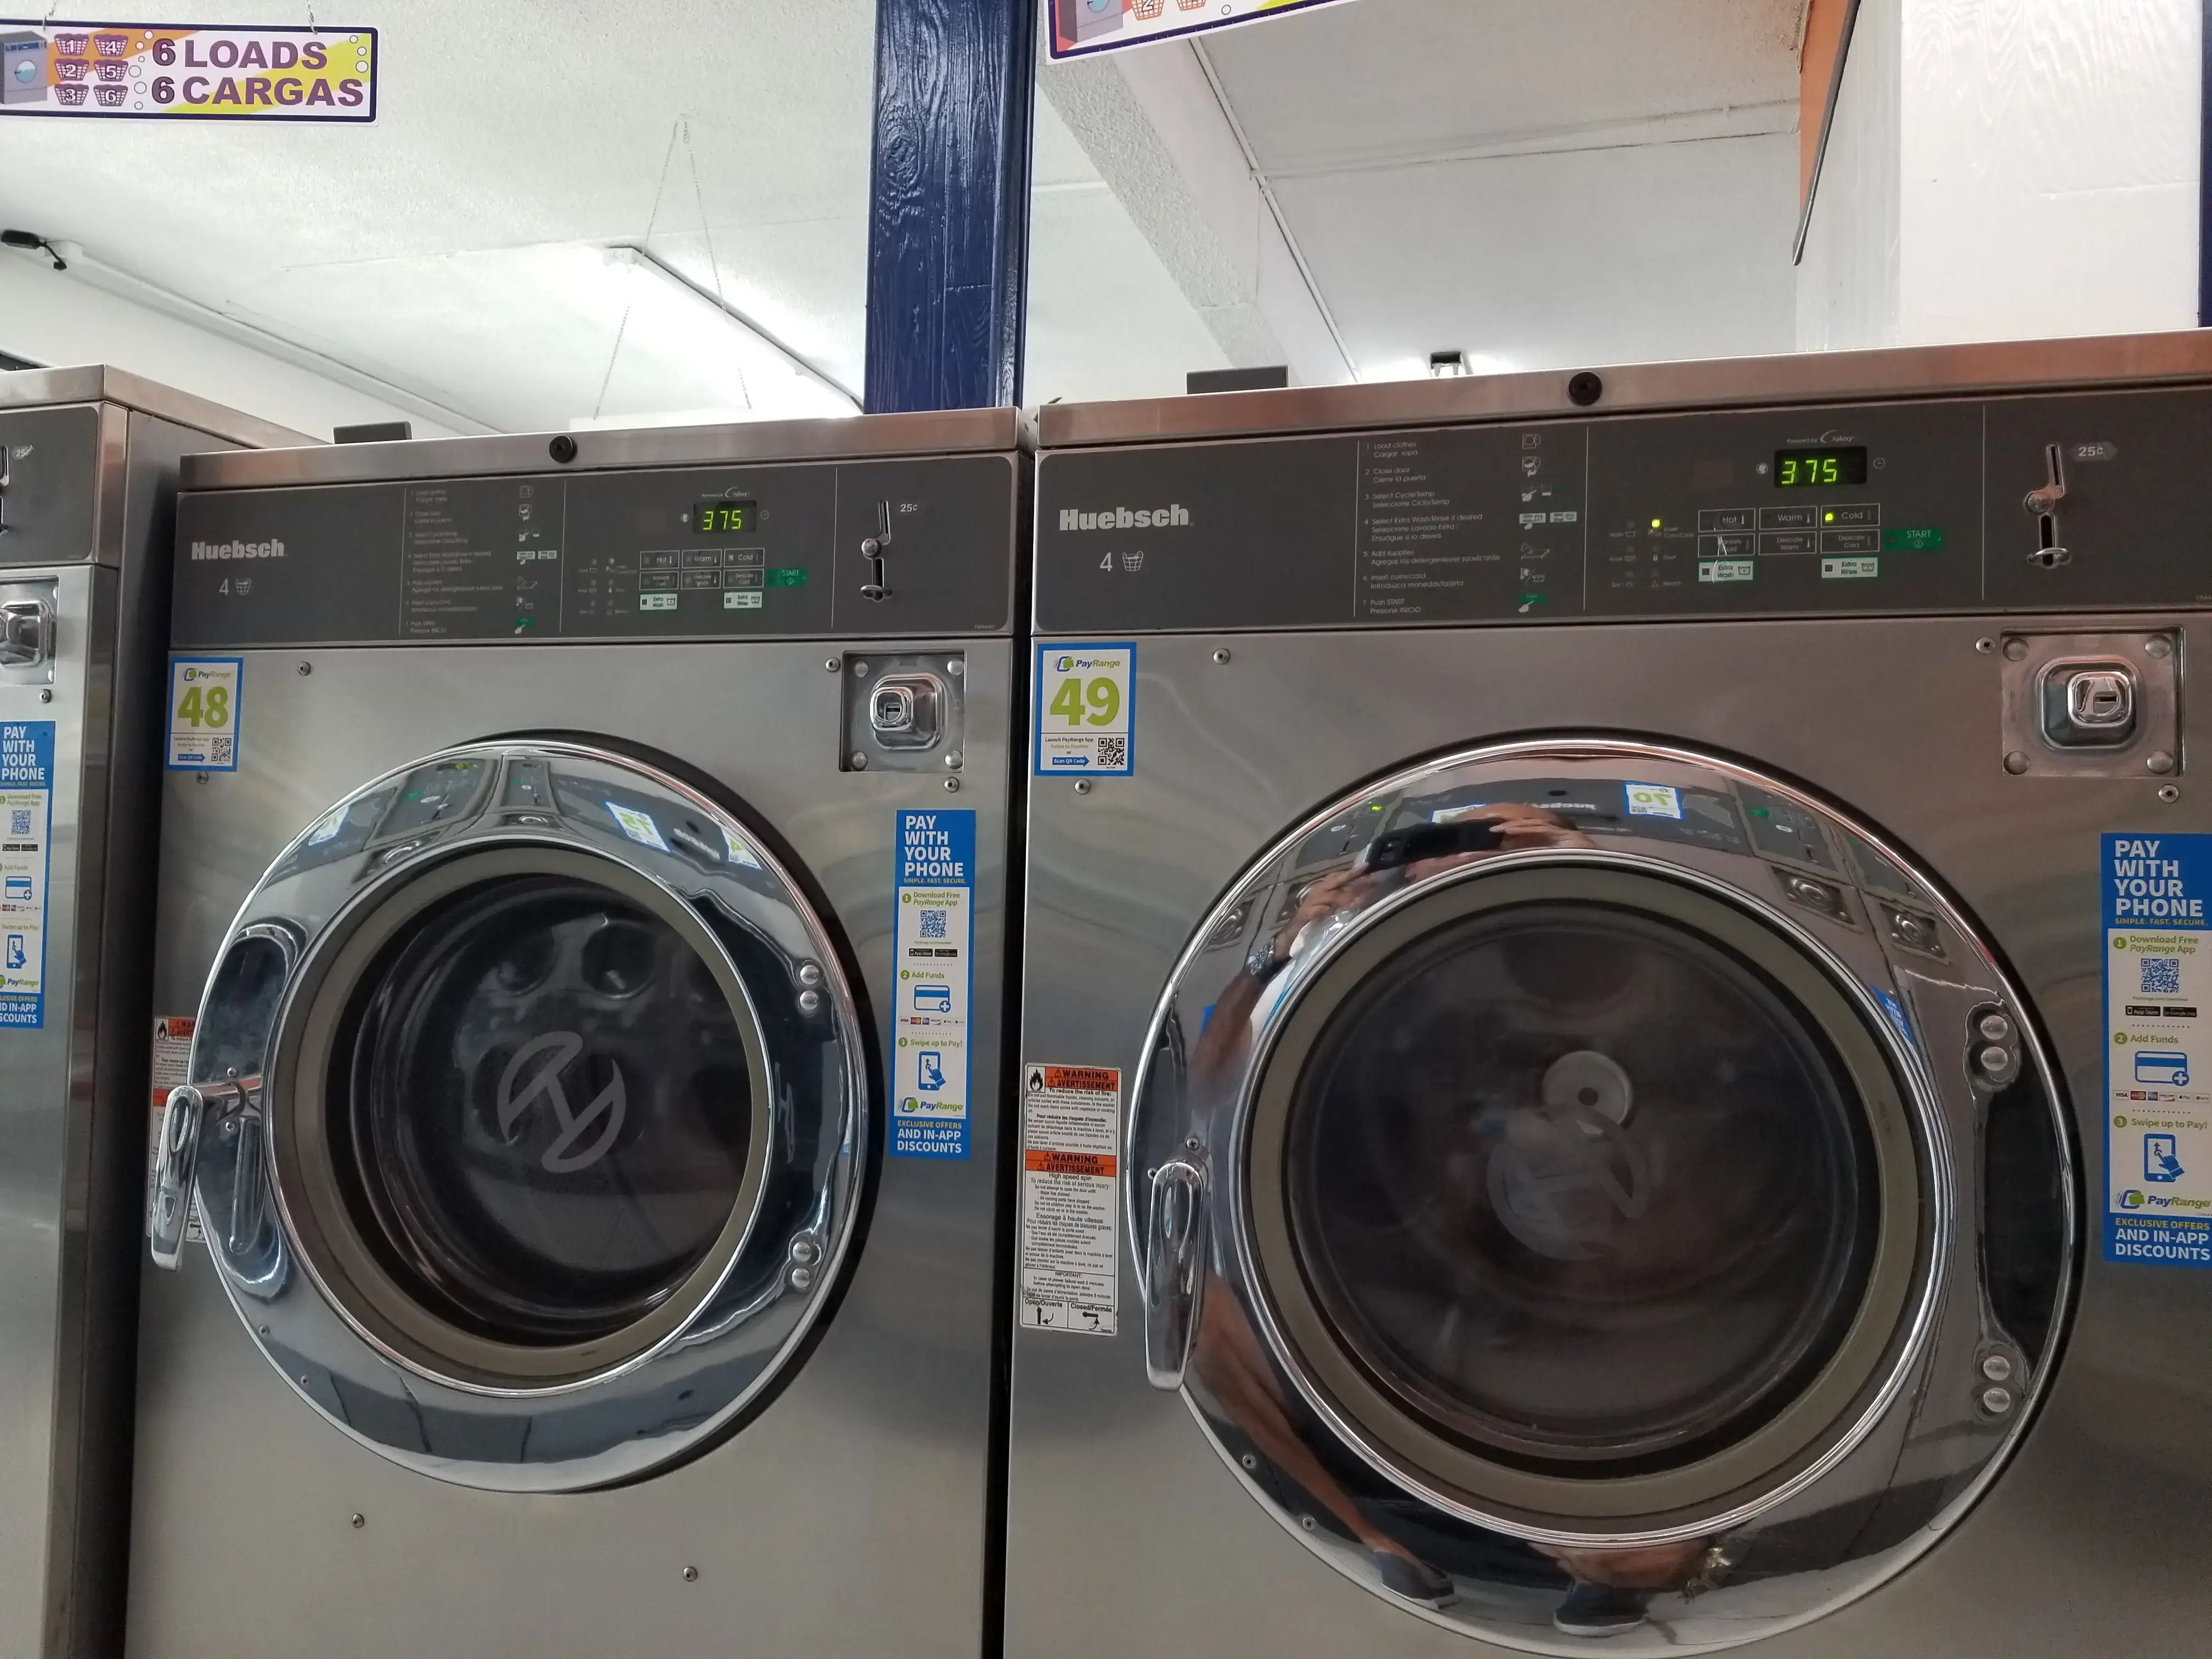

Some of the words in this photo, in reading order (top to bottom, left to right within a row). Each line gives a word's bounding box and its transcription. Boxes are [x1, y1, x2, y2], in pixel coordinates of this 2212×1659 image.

[67, 40, 75, 54] 1
[105, 41, 117, 54] 4
[152, 38, 176, 66] 6
[184, 40, 328, 70] LOADS
[65, 64, 76, 77] 2
[105, 65, 117, 78] 5
[65, 88, 76, 101] 3
[105, 89, 116, 103] 6
[151, 76, 175, 104] 6
[182, 77, 364, 107] CARGAS
[1781, 459, 1837, 484] 375
[702, 510, 742, 531] 375
[1059, 504, 1189, 532] Huebsch
[1841, 512, 1863, 520] Cold
[1906, 529, 1932, 538] START
[191, 538, 285, 561] Huebsch
[1099, 552, 1113, 572] 4
[219, 578, 229, 596] 4
[1075, 659, 1121, 669] PayRange
[178, 686, 228, 728] 48
[1049, 676, 1120, 726] 49
[4, 726, 26, 739] PAY
[3, 740, 35, 753] WITH
[2, 753, 36, 767] YOUR
[2, 768, 45, 781] PHONE
[906, 815, 936, 830] PAY
[905, 831, 949, 845] WITH
[904, 847, 951, 861] YOUR
[2115, 840, 2160, 857] PAY
[905, 862, 964, 877] PHONE
[2114, 860, 2179, 877] WITH
[2114, 878, 2184, 897] YOUR
[2116, 898, 2203, 917] PHONE
[2130, 935, 2177, 944] Download
[2179, 935, 2199, 944] Free
[2129, 944, 2176, 954] PayRange
[2177, 945, 2196, 955] App
[9, 1003, 37, 1012] IN-APP
[0, 1012, 37, 1024] SCOUNTS
[910, 1039, 930, 1047] Swipe
[949, 1039, 962, 1048] Pay!
[2130, 1034, 2148, 1043] Add
[2151, 1035, 2179, 1043] Funds
[1062, 1069, 1109, 1080] WARNING
[1057, 1079, 1115, 1090] AVERTISSEMENT
[919, 1101, 963, 1112] PayRange
[2131, 1118, 2159, 1127] Swipe
[2162, 1120, 2172, 1128] up
[2175, 1119, 2185, 1128] to
[2187, 1120, 2208, 1131] Pay!
[898, 1128, 922, 1139] AND
[923, 1130, 961, 1142] IN-APP
[897, 1140, 962, 1154] DISCOUNTS
[1052, 1153, 1098, 1164] WARNING
[1047, 1162, 1104, 1175] AVERTISSEMENT
[2147, 1195, 2211, 1209] PayRange
[1036, 1212, 1061, 1221] Essorage
[2115, 1217, 2169, 1228] EXCLUSIVE
[2170, 1221, 2210, 1231] OFFERS
[2115, 1228, 2149, 1242] AND
[2153, 1229, 2209, 1245] IN-APP
[2115, 1242, 2210, 1261] DISCOUNTS
[1025, 1299, 1063, 1308] Open/Ouverte
[1070, 1303, 1113, 1313] Closed/Fermée
